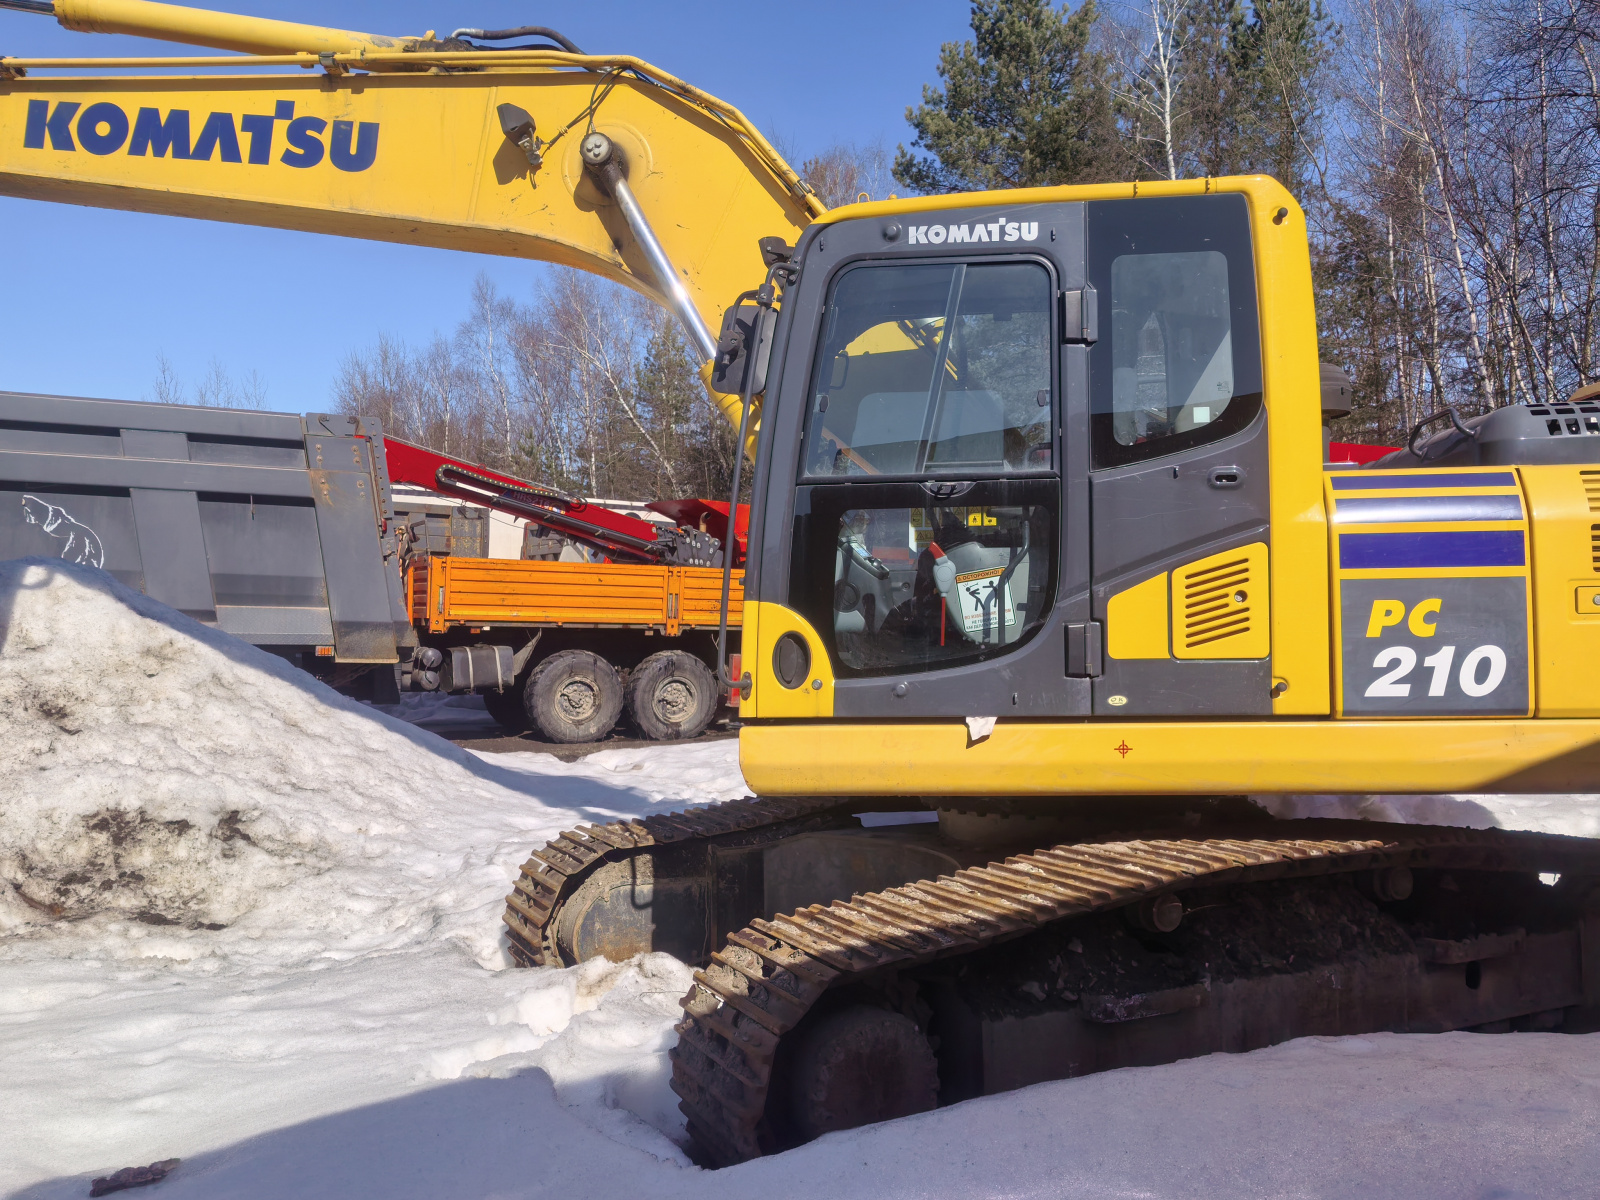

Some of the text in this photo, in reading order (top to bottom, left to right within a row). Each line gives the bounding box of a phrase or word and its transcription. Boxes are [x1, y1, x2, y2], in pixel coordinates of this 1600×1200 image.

[24, 100, 380, 172] KOMATSU
[908, 217, 1039, 245] KOMATSU
[962, 570, 1000, 580] ОСТОРОЖНО!
[1366, 598, 1442, 637] PC
[1364, 644, 1507, 697] 210
